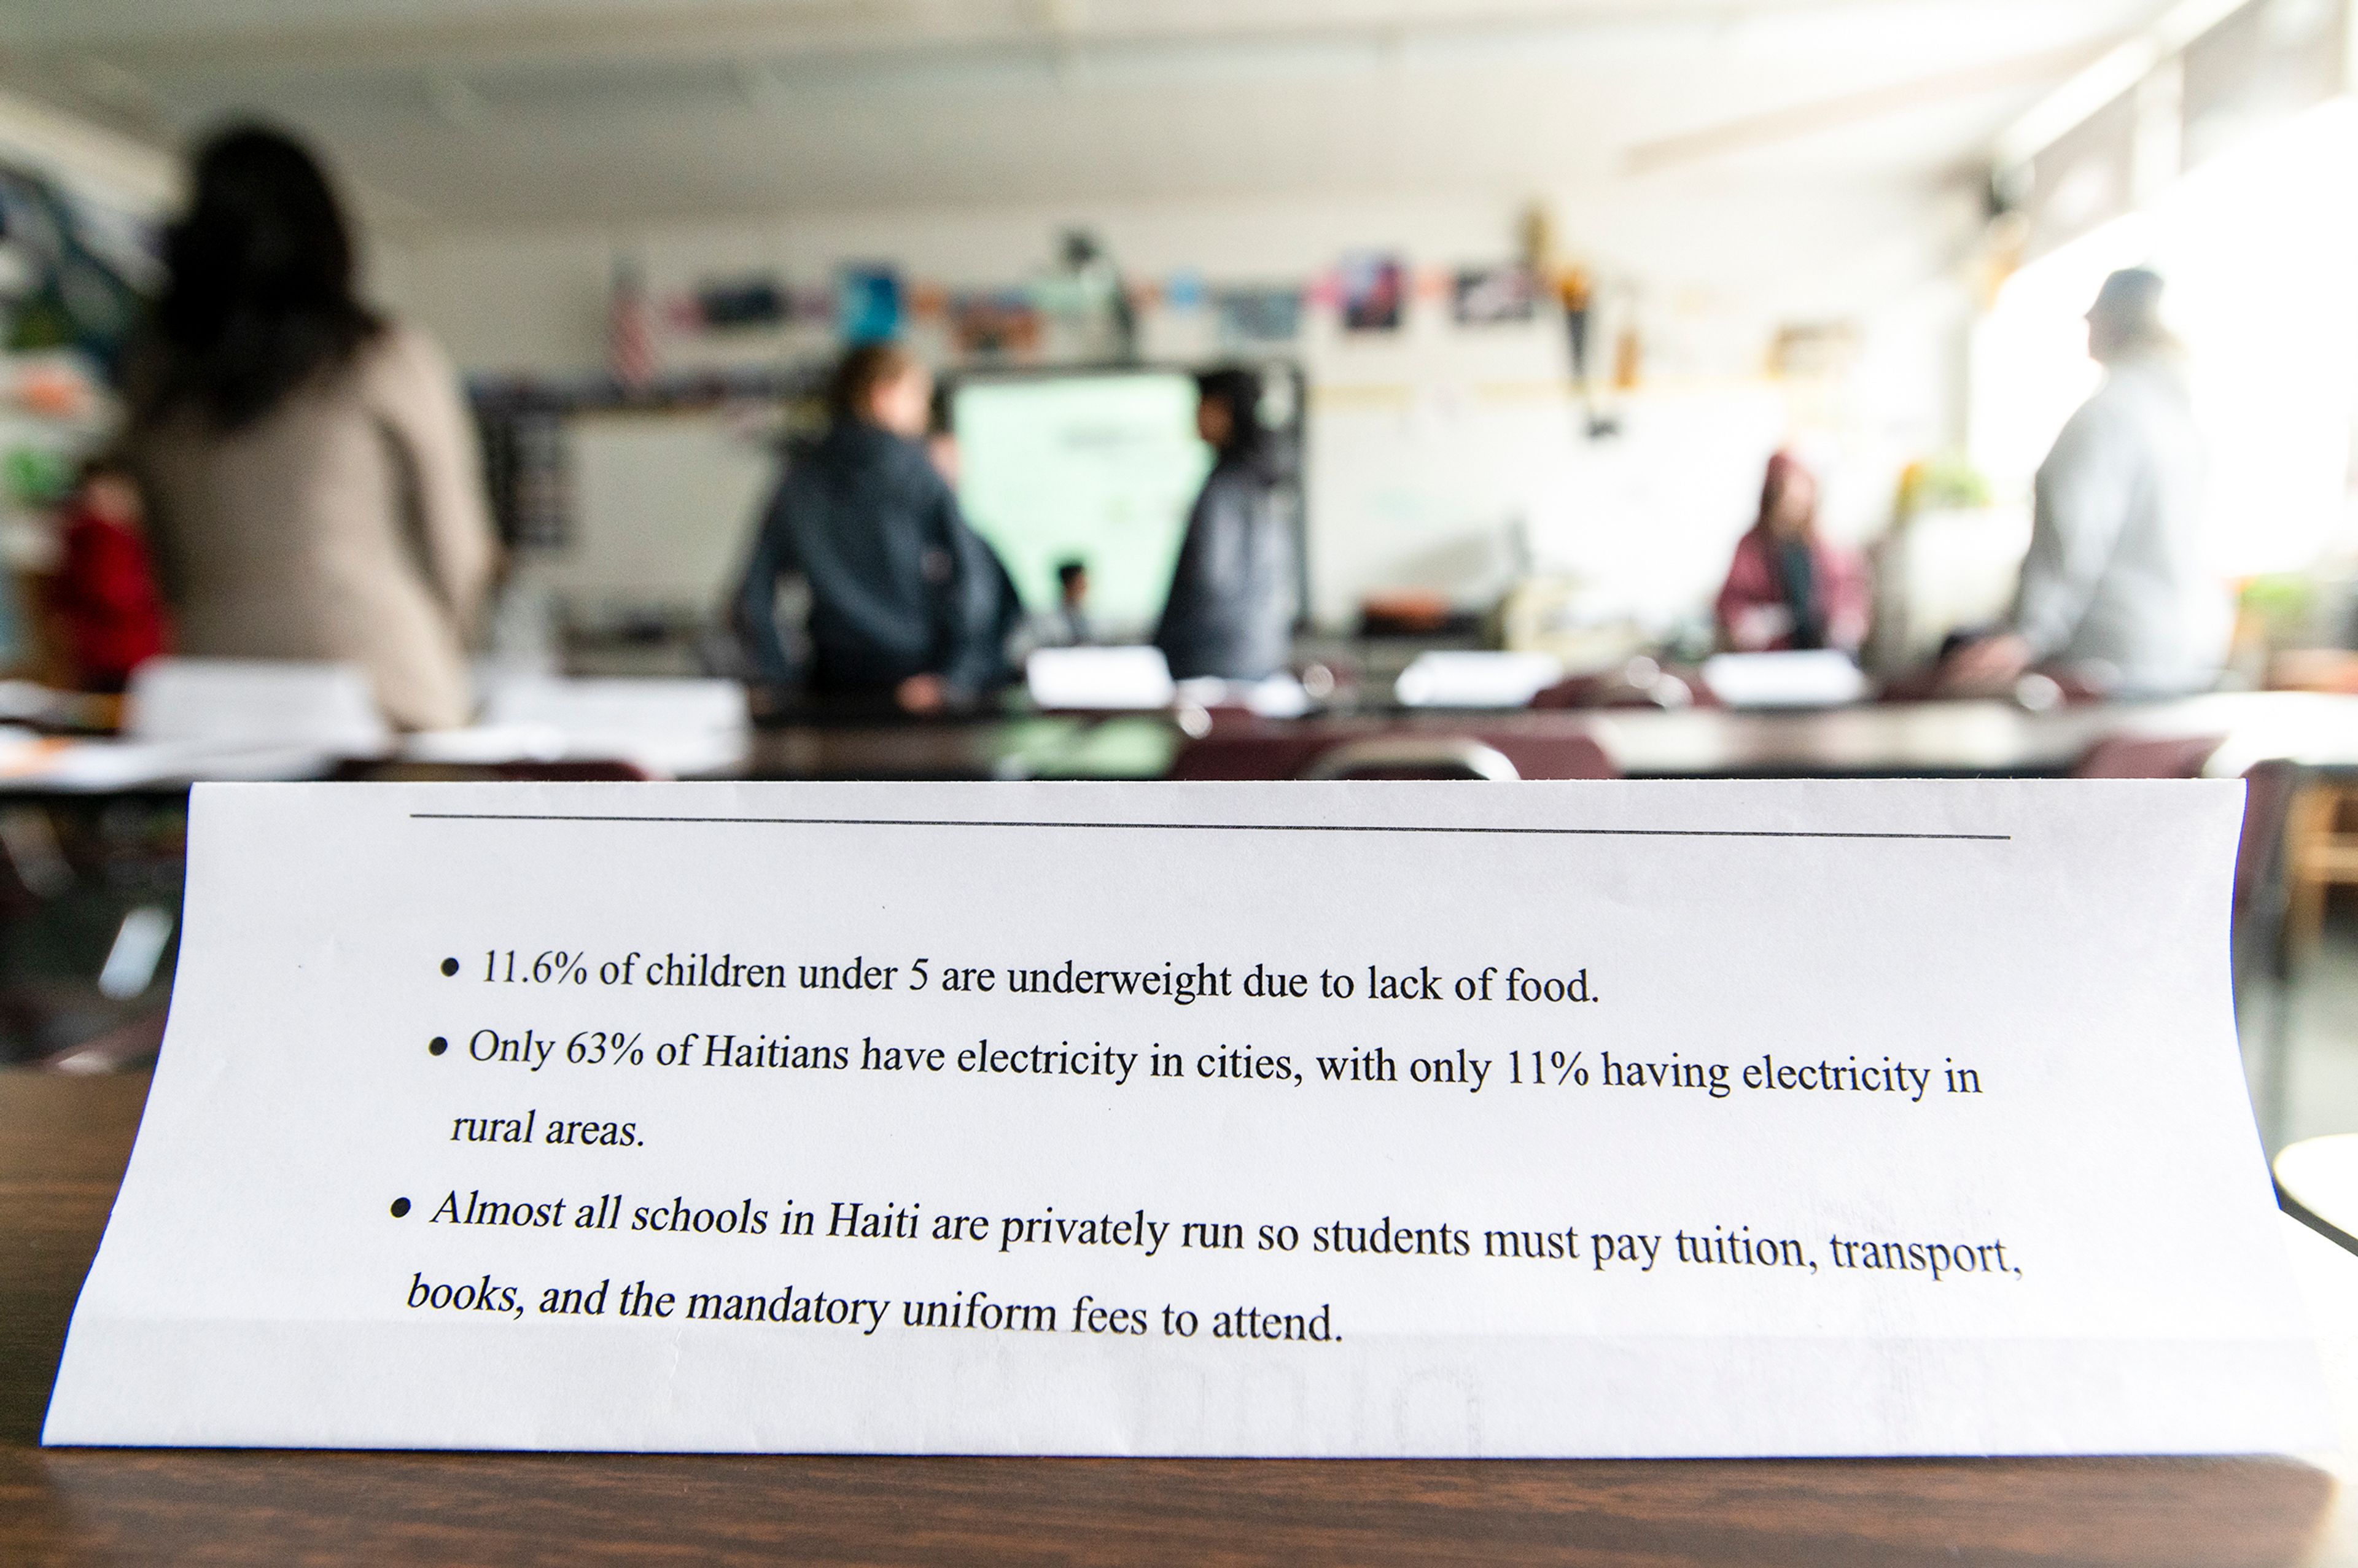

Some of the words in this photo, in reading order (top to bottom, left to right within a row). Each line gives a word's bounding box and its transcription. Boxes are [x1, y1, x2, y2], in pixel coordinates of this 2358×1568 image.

[484, 949, 588, 985] 11.6%
[599, 952, 641, 985] of
[646, 952, 787, 988] children
[798, 955, 899, 990] under
[909, 958, 929, 991] 5
[942, 968, 995, 992] are
[1006, 959, 1232, 1006] underweight
[1243, 963, 1308, 998] due
[1319, 968, 1355, 999] to
[1368, 964, 1444, 1000] lack
[1455, 966, 1498, 1001] of
[1505, 967, 1598, 1003] food.
[469, 1029, 556, 1072] Only
[567, 1031, 644, 1066] 63%
[656, 1033, 699, 1066] of
[702, 1034, 849, 1070] Haitians
[860, 1036, 945, 1071] have
[957, 1039, 1138, 1086] electricity
[1150, 1042, 1185, 1077] in
[1196, 1044, 1302, 1087] cities,
[1315, 1046, 1398, 1082] with
[1410, 1048, 1493, 1093] only
[1509, 1050, 1589, 1086] 11%
[1600, 1050, 1730, 1099] having
[1743, 1054, 1931, 1103] electricity
[1944, 1057, 1983, 1093] in
[450, 1109, 536, 1143] rural
[545, 1120, 644, 1147] areas.
[429, 1189, 567, 1227] Almost
[574, 1193, 623, 1230] all
[631, 1196, 768, 1235] schools
[780, 1199, 814, 1236] in
[825, 1201, 920, 1239] Haiti
[932, 1215, 989, 1241] are
[998, 1206, 1170, 1257] privately
[1181, 1222, 1244, 1249] run
[1258, 1225, 1299, 1251] so
[1313, 1216, 1470, 1256] students
[1484, 1226, 1579, 1259] must
[1590, 1234, 1662, 1272] pay
[1675, 1225, 1817, 1272] tuition,
[1829, 1234, 2021, 1281] transport,
[407, 1271, 524, 1321] books,
[539, 1278, 610, 1316] and
[619, 1279, 675, 1318] the
[685, 1285, 891, 1336] mandatory
[903, 1290, 1056, 1332] uniform
[1071, 1295, 1148, 1336] fees
[1162, 1303, 1199, 1338] to
[1212, 1303, 1342, 1342] attend.
